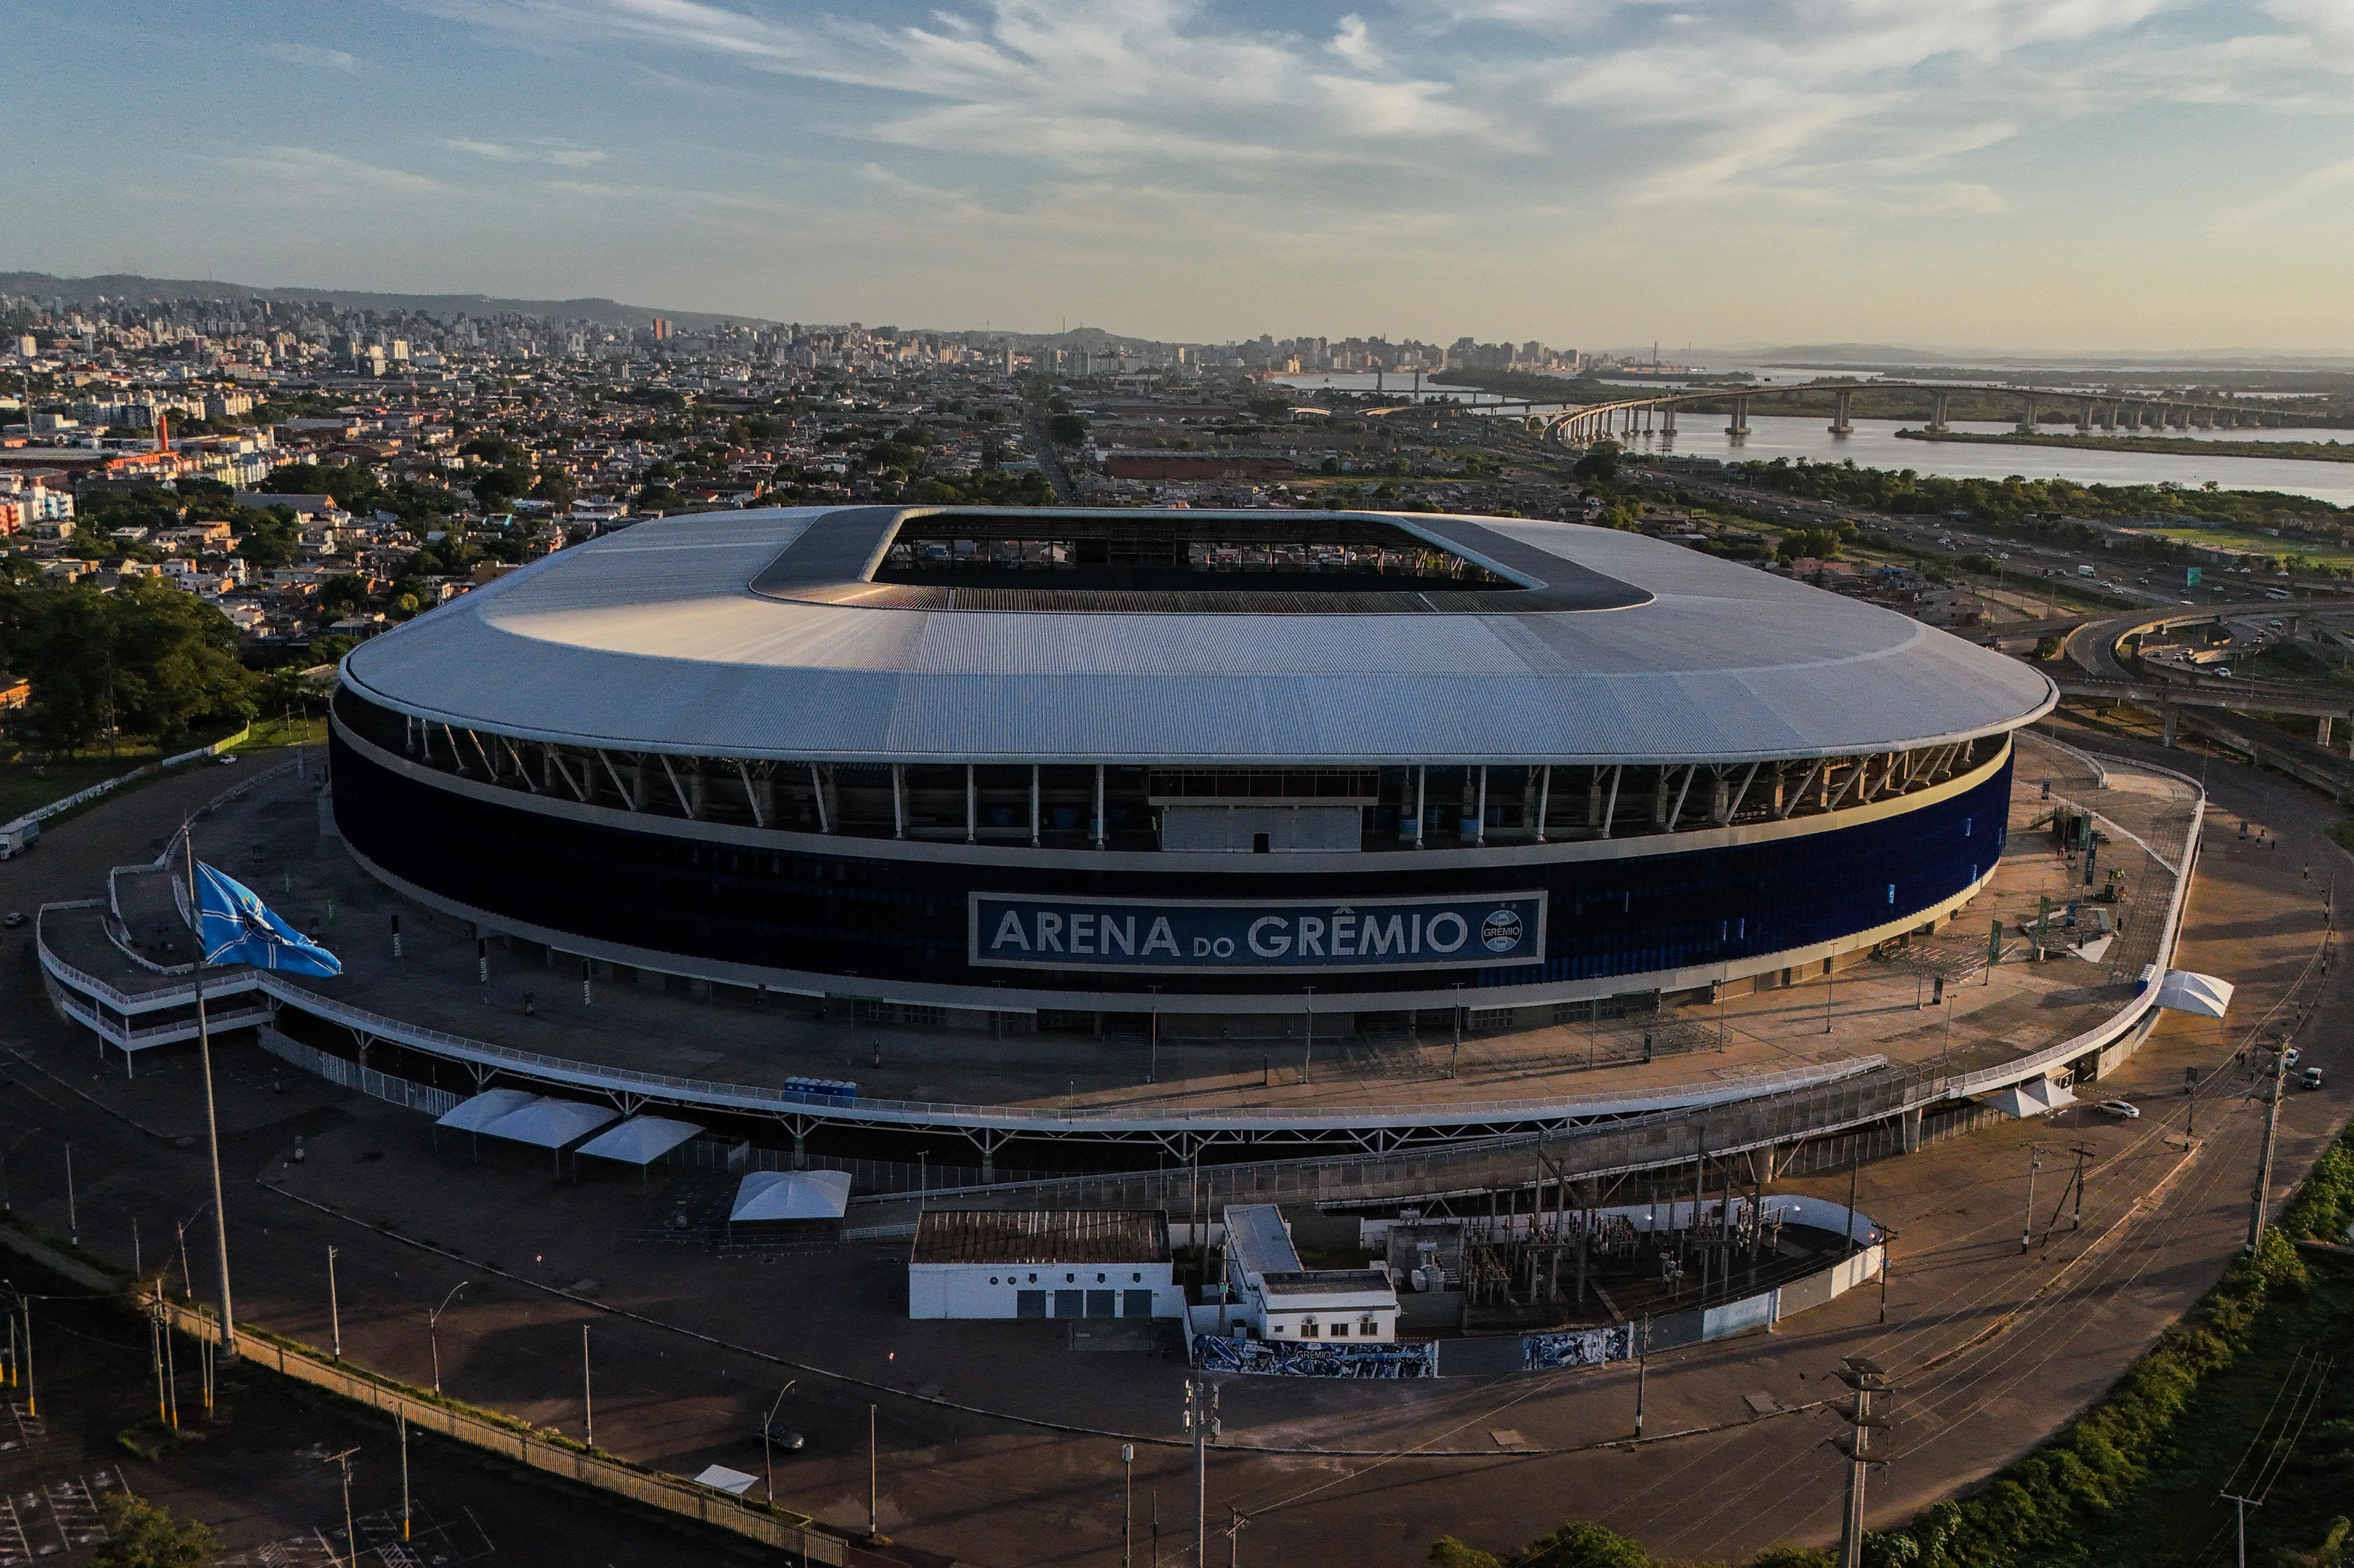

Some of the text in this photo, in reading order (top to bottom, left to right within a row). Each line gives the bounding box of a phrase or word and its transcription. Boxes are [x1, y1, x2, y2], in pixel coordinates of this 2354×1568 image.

[991, 907, 1469, 958] ARENA DO GRÊMIO
[1484, 926, 1520, 937] GRÊMIO
[393, 932, 402, 956] BRAHMA
[2065, 1076, 2069, 1086] 2
